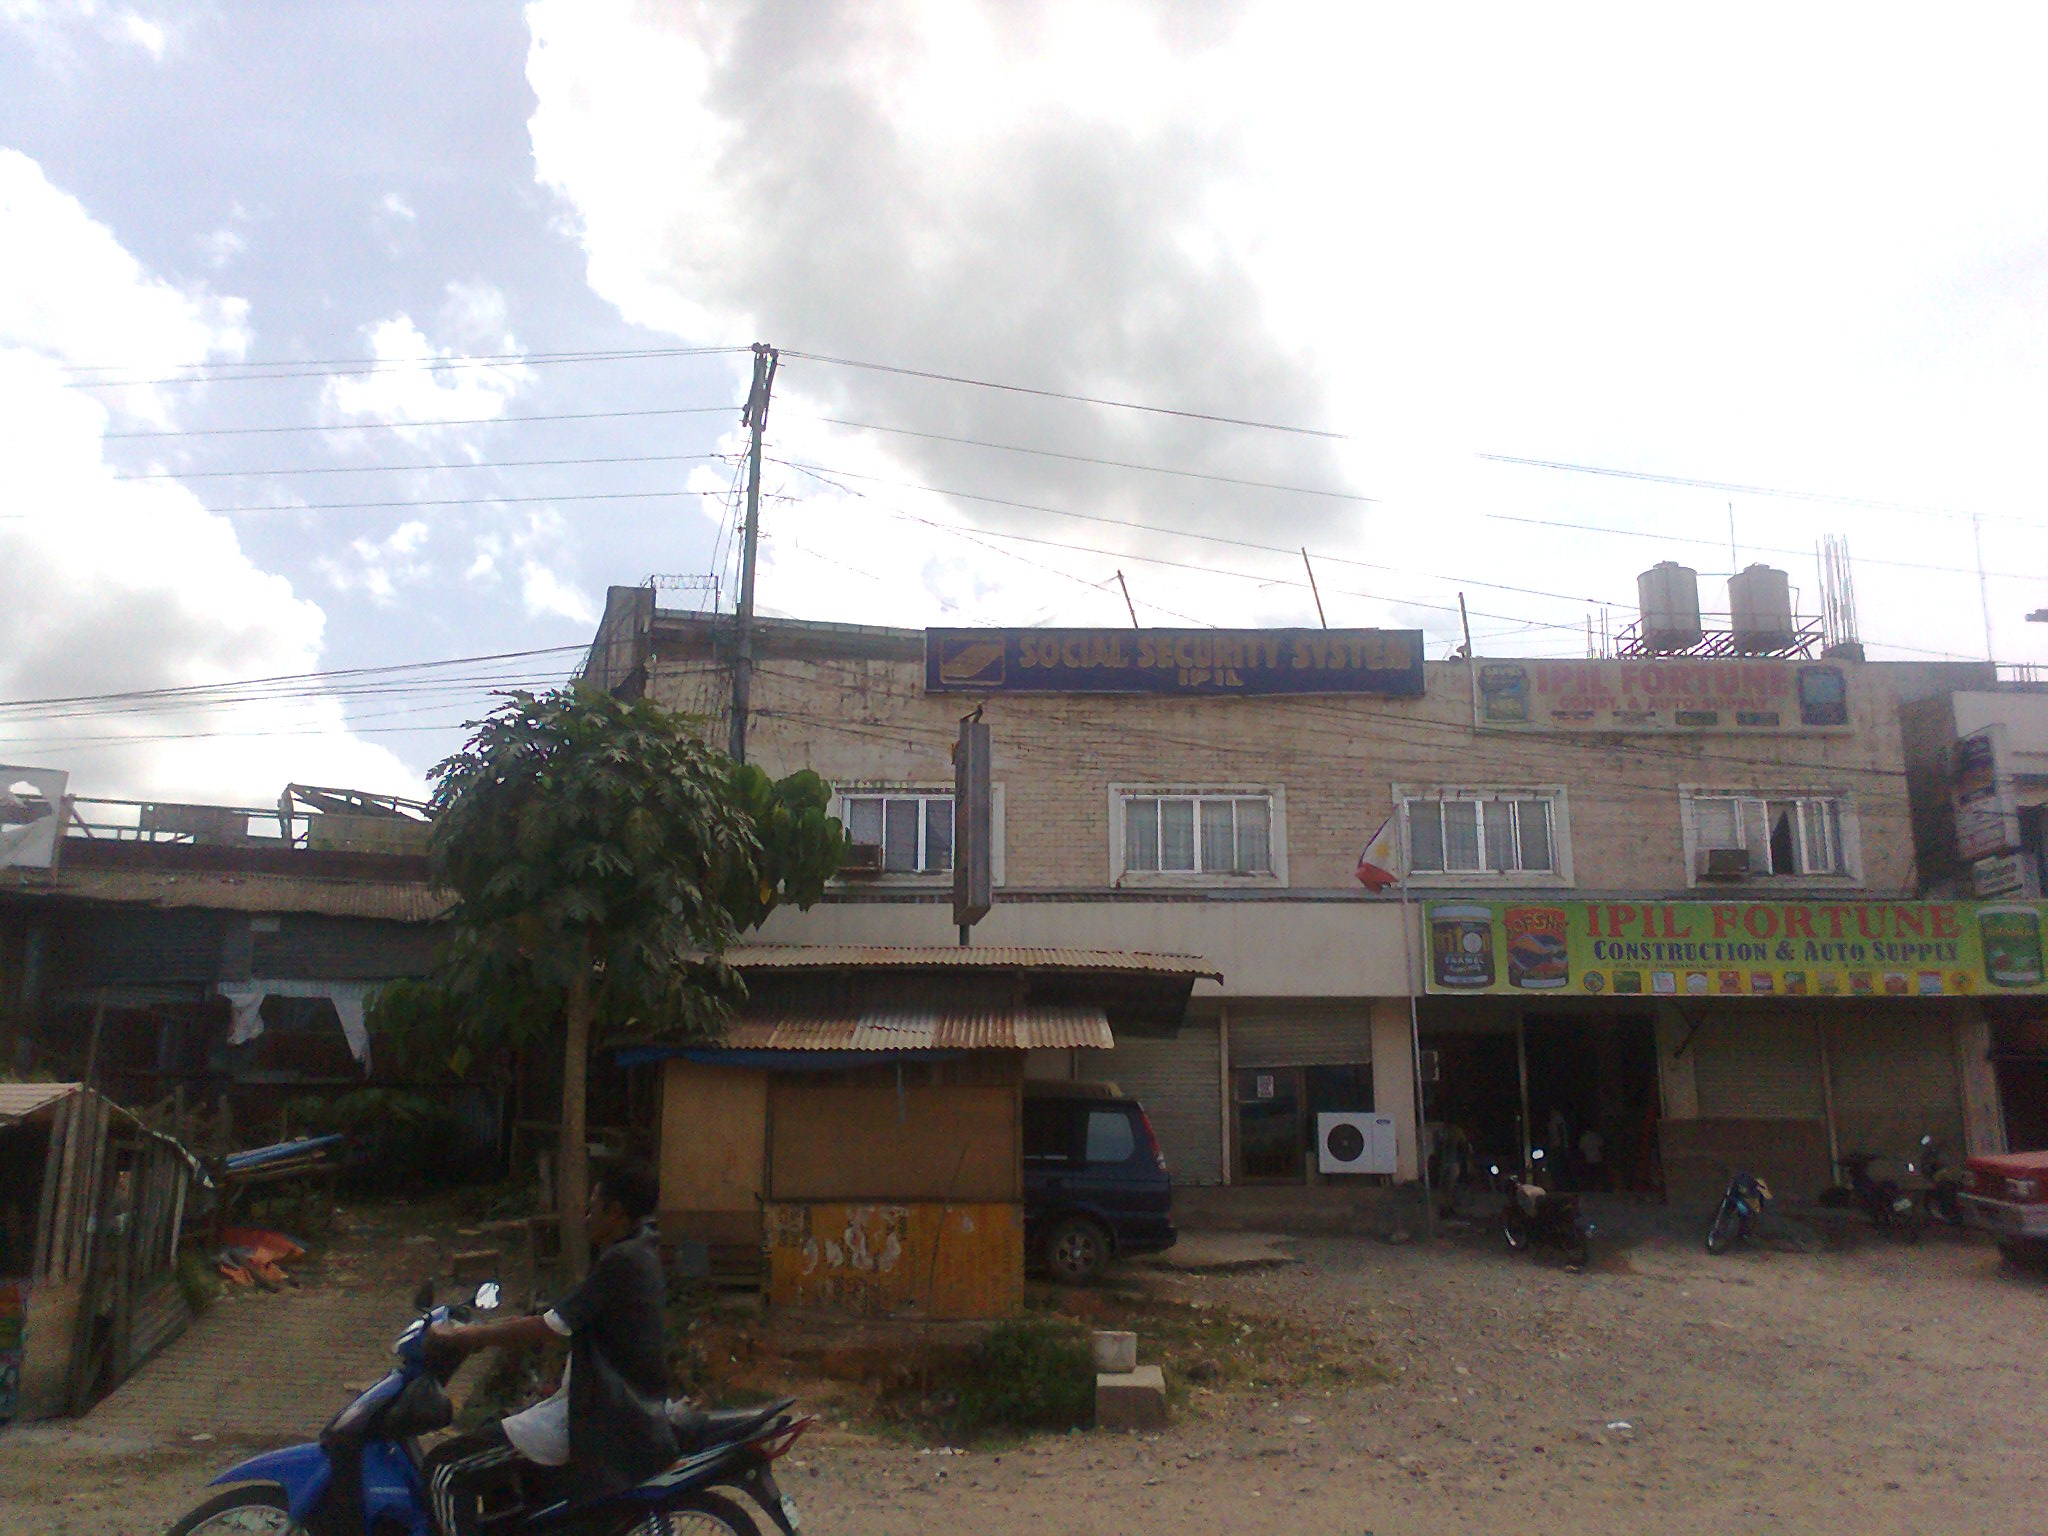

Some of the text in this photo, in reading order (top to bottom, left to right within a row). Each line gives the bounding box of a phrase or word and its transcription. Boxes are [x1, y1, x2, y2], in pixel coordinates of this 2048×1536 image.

[1018, 633, 1413, 671] SOCIAL SECURITY SYSTEM
[1178, 668, 1244, 688] IPIL
[1536, 664, 1791, 697] IPIL FORTUNE
[1586, 904, 1964, 939] IPIL FORTUNE
[1774, 940, 1795, 961] &
